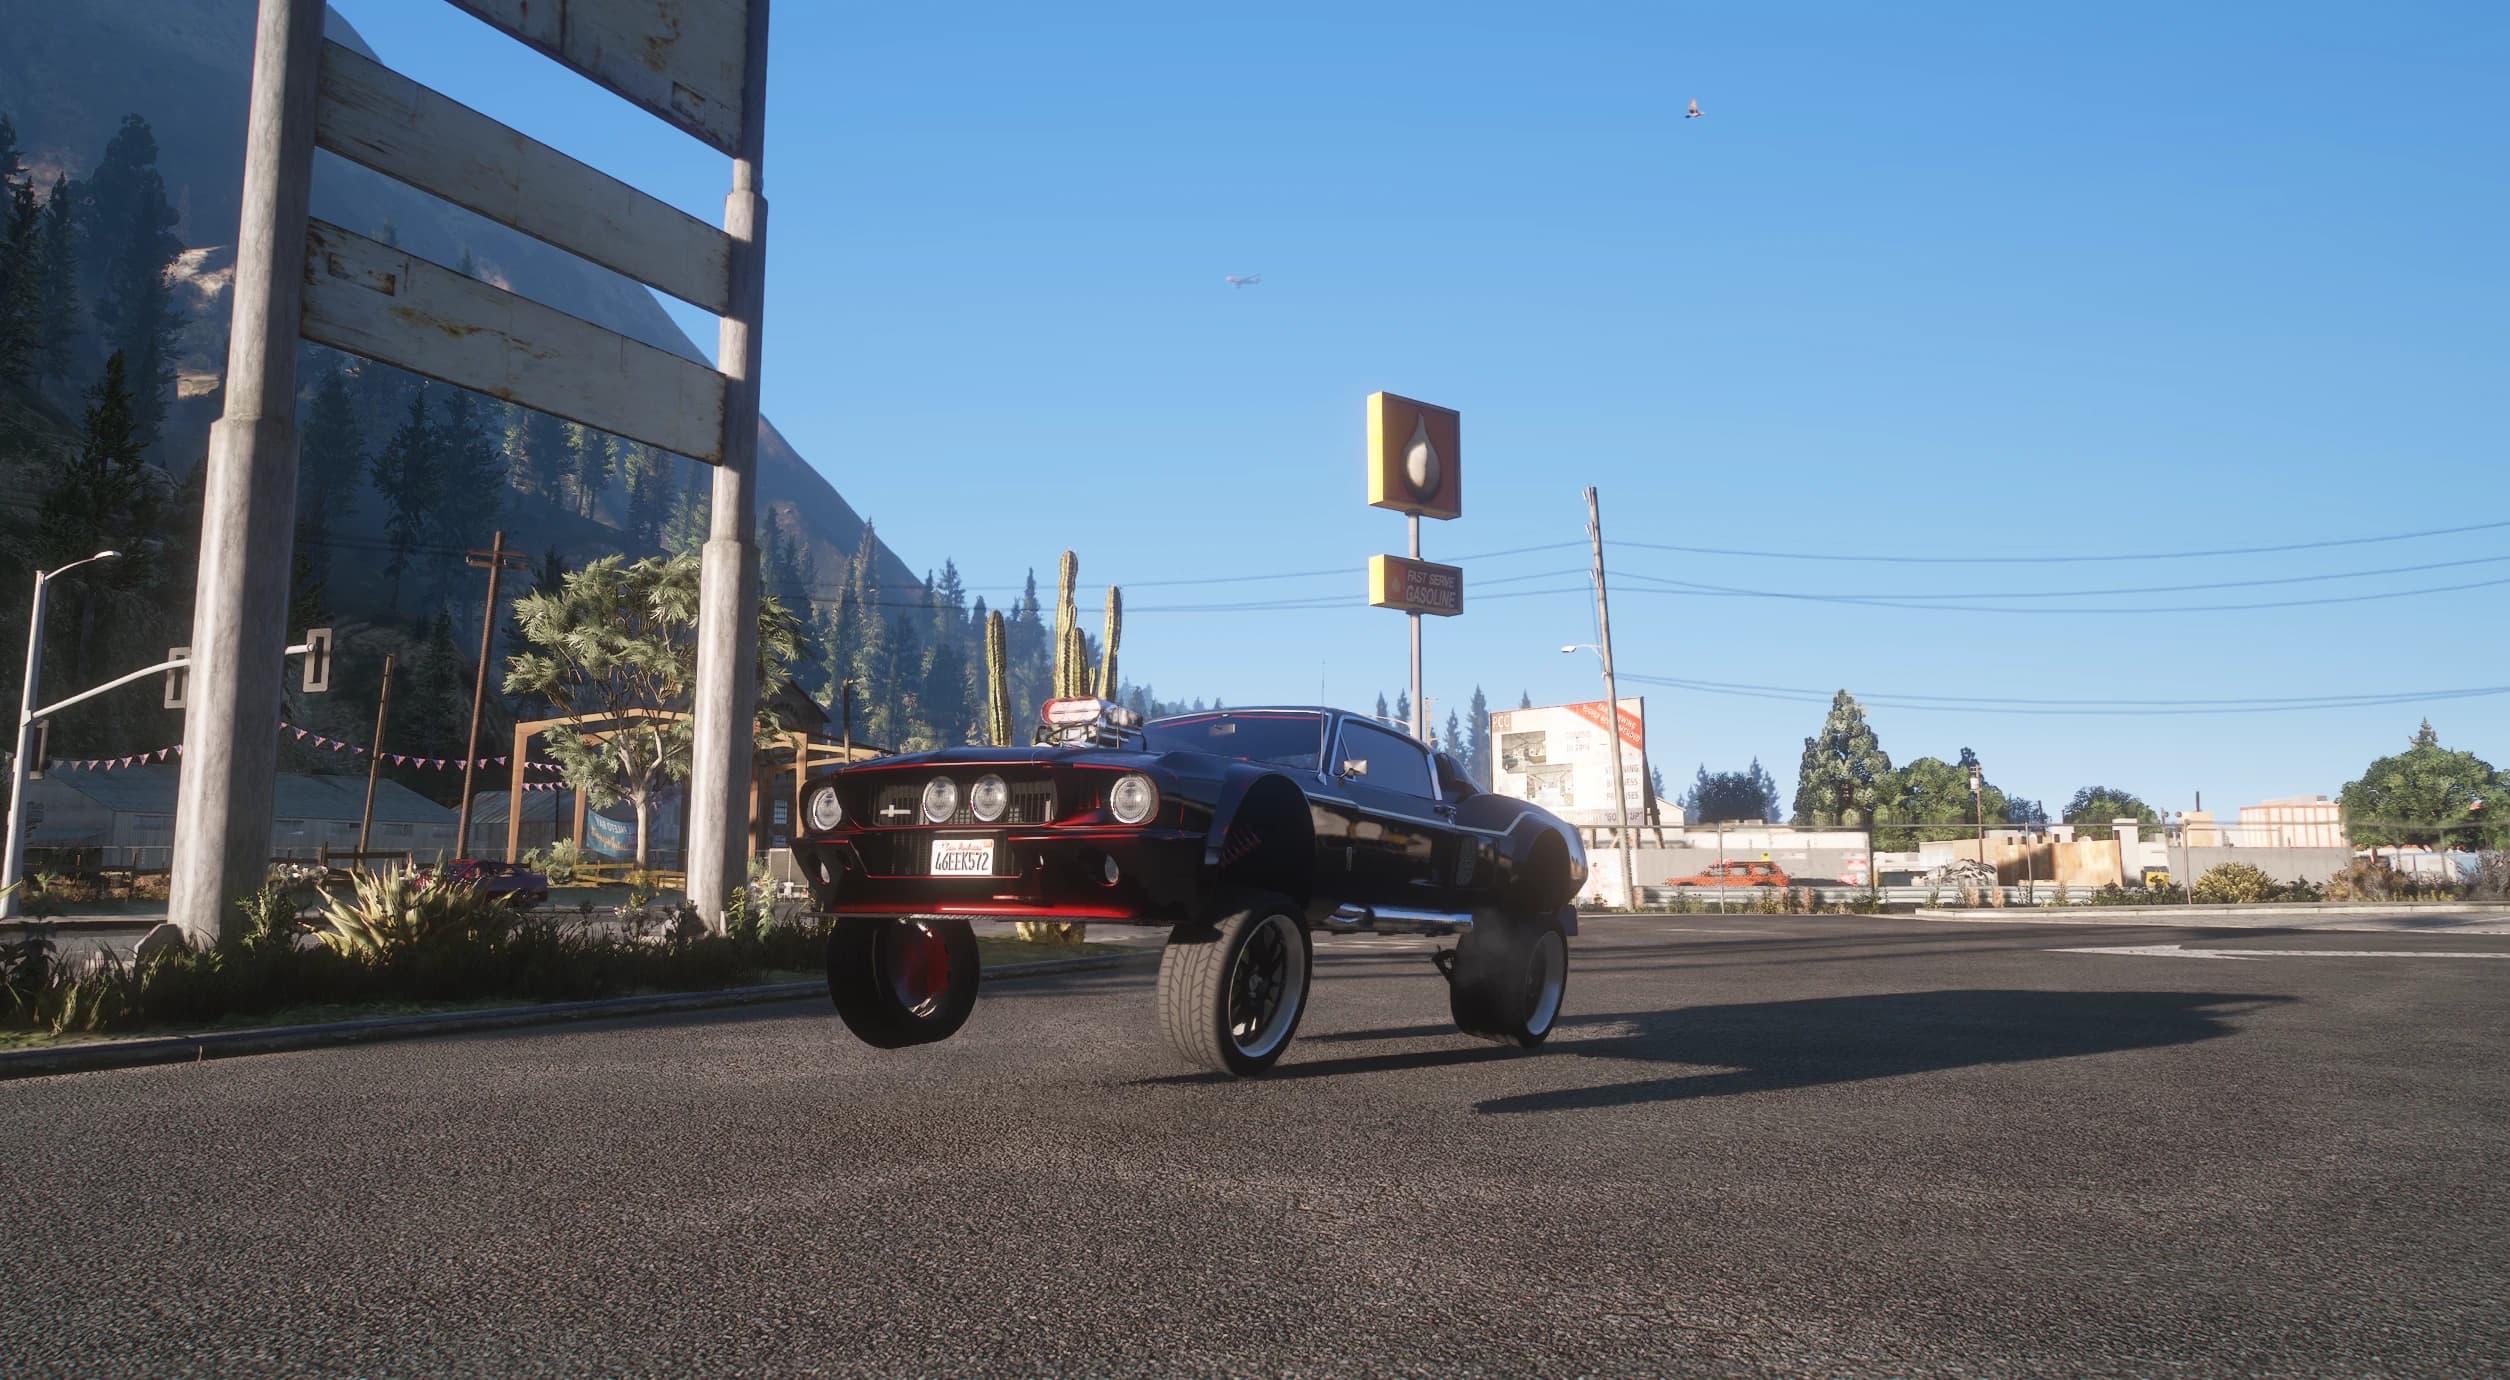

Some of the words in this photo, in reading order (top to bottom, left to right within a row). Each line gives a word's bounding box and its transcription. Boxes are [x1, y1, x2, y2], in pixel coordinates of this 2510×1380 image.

[1408, 569, 1427, 583] FAST
[1429, 574, 1455, 588] SERVE
[1407, 585, 1456, 608] GASOLINE
[935, 851, 989, 871] 46EEK572
